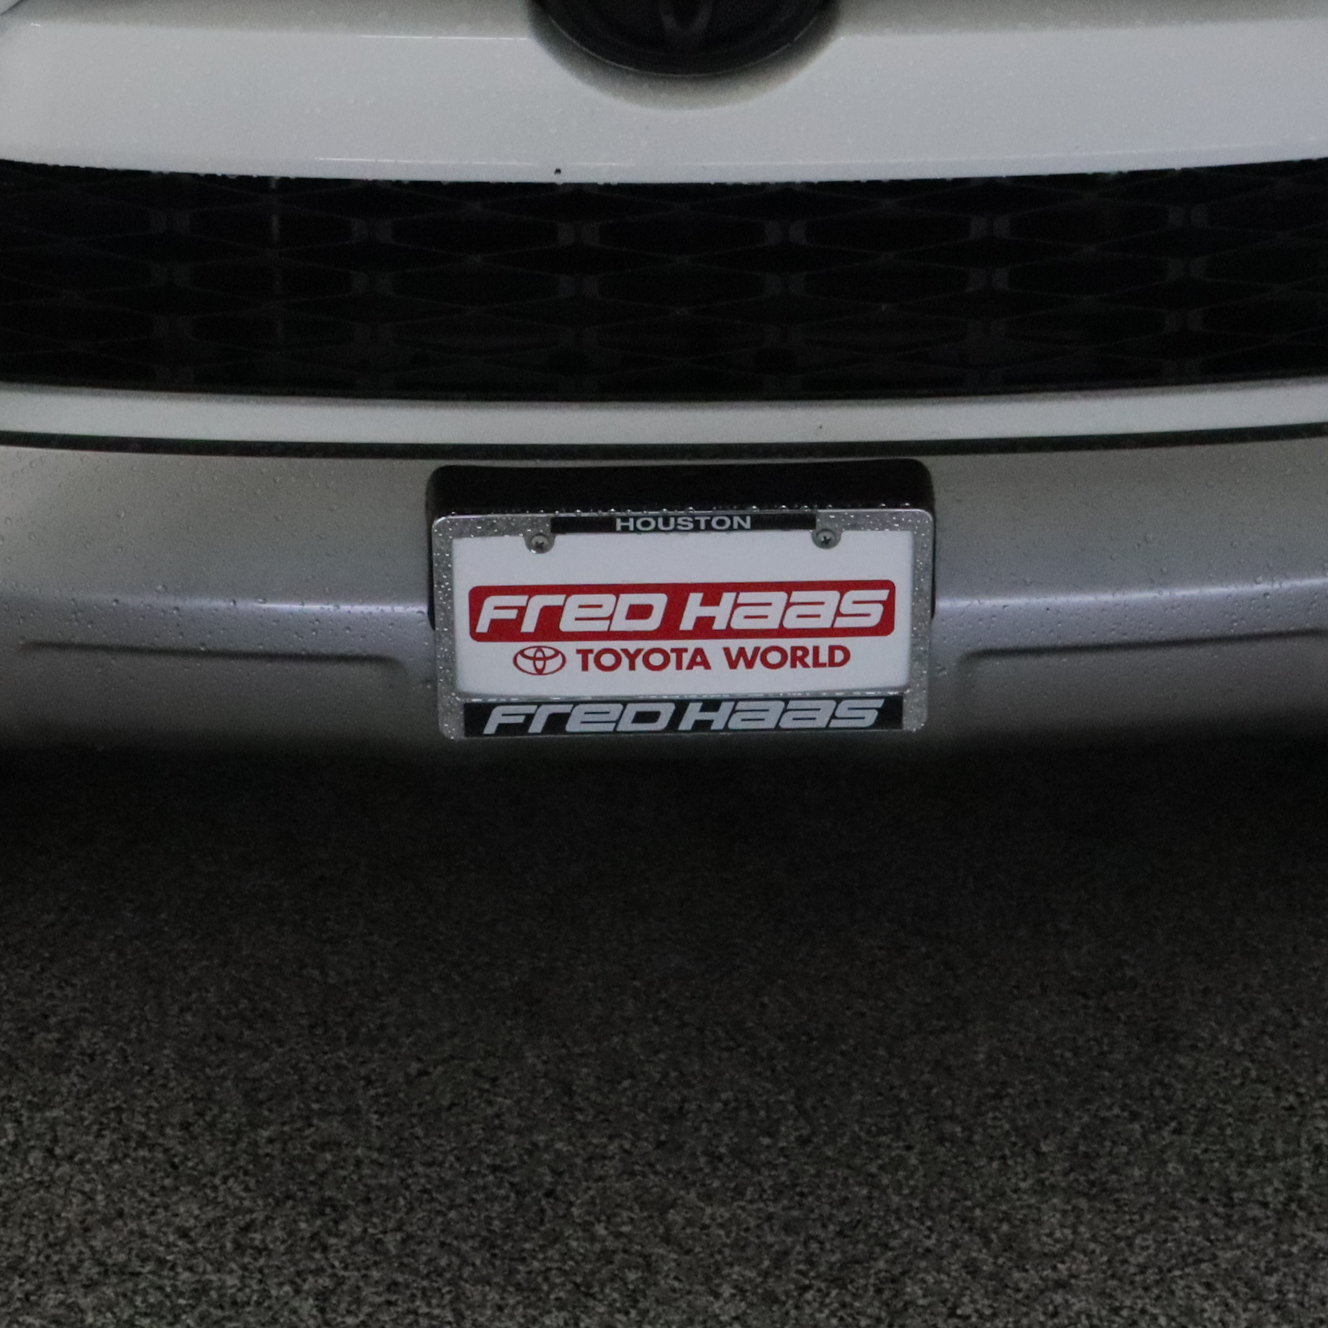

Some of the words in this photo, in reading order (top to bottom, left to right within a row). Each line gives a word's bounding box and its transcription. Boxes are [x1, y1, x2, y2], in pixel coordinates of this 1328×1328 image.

[615, 515, 752, 532] HOUSTON
[576, 647, 711, 671] TOYOTA
[722, 644, 851, 669] WORLD
